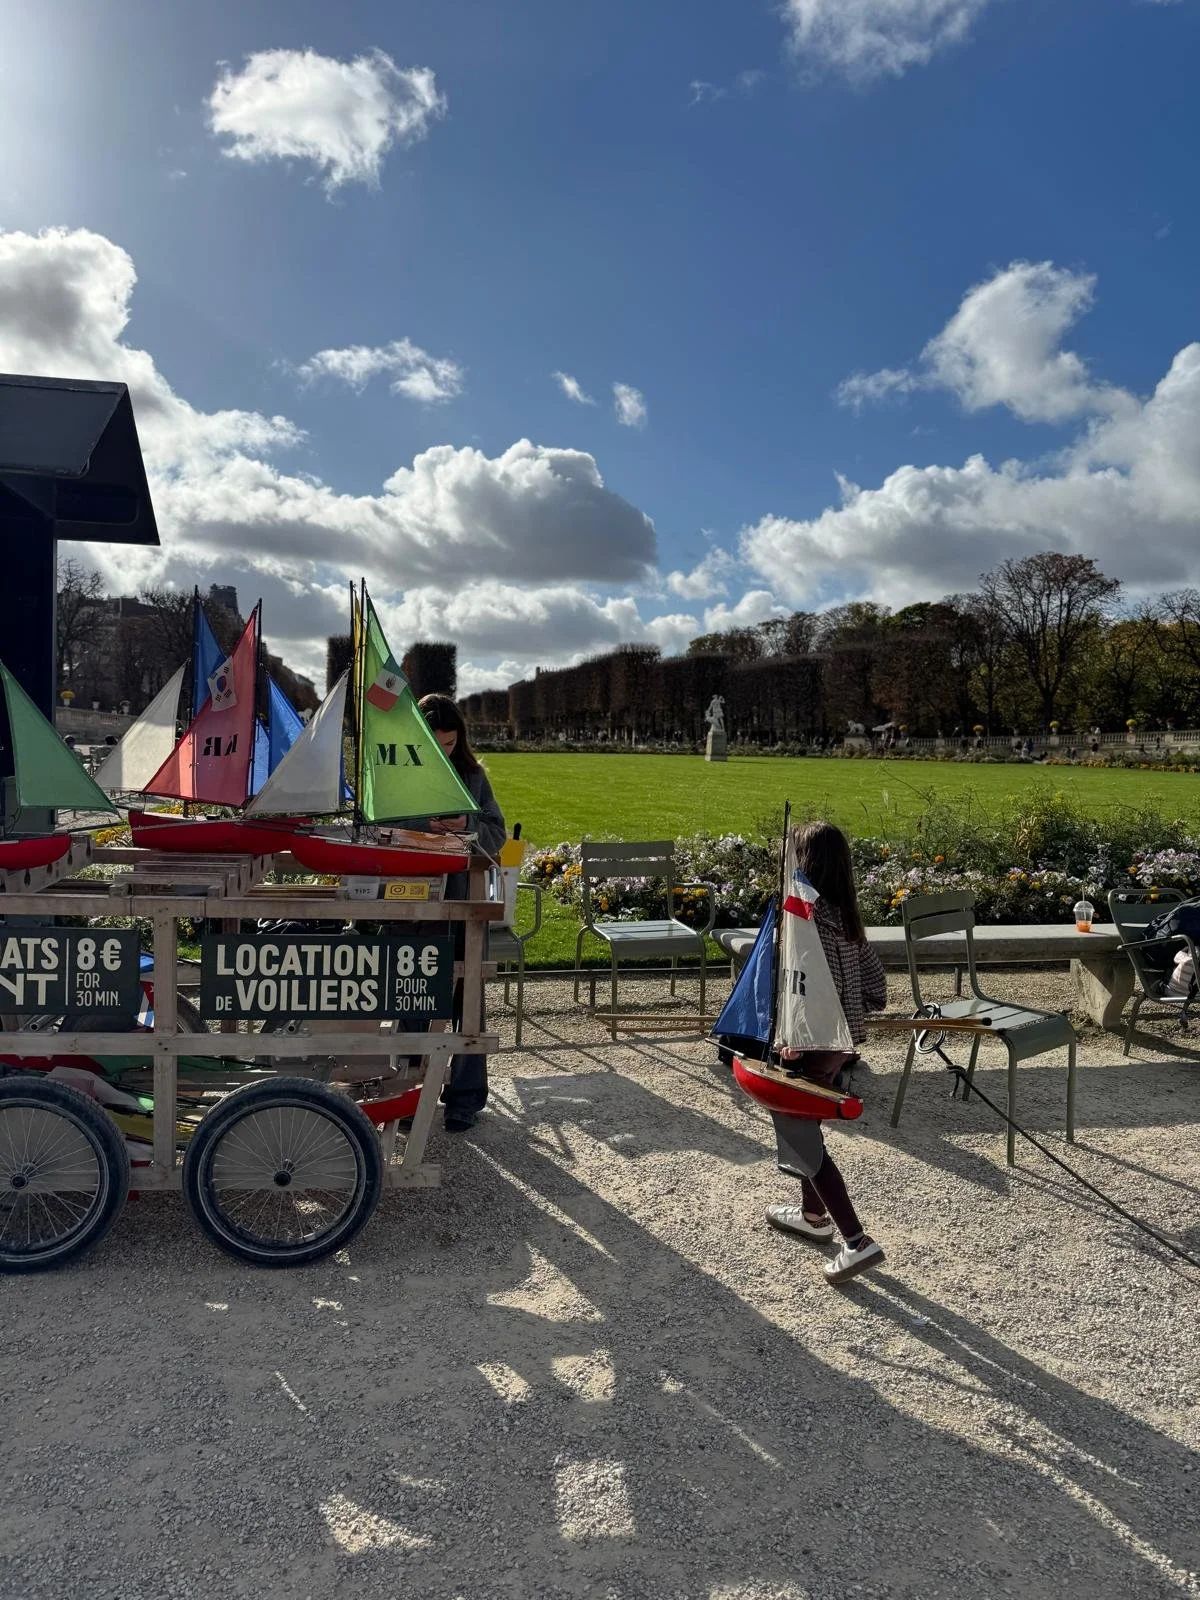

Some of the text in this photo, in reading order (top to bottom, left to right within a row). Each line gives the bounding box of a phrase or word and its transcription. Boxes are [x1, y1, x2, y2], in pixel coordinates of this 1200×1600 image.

[376, 743, 424, 766] MX
[216, 943, 380, 977] LOCATION
[76, 972, 101, 989] FOR
[395, 977, 428, 995] POUR
[75, 990, 121, 1007] 30 MIN.
[215, 978, 379, 1012] DE VOILIERS
[395, 995, 438, 1012] 30 MIN.
